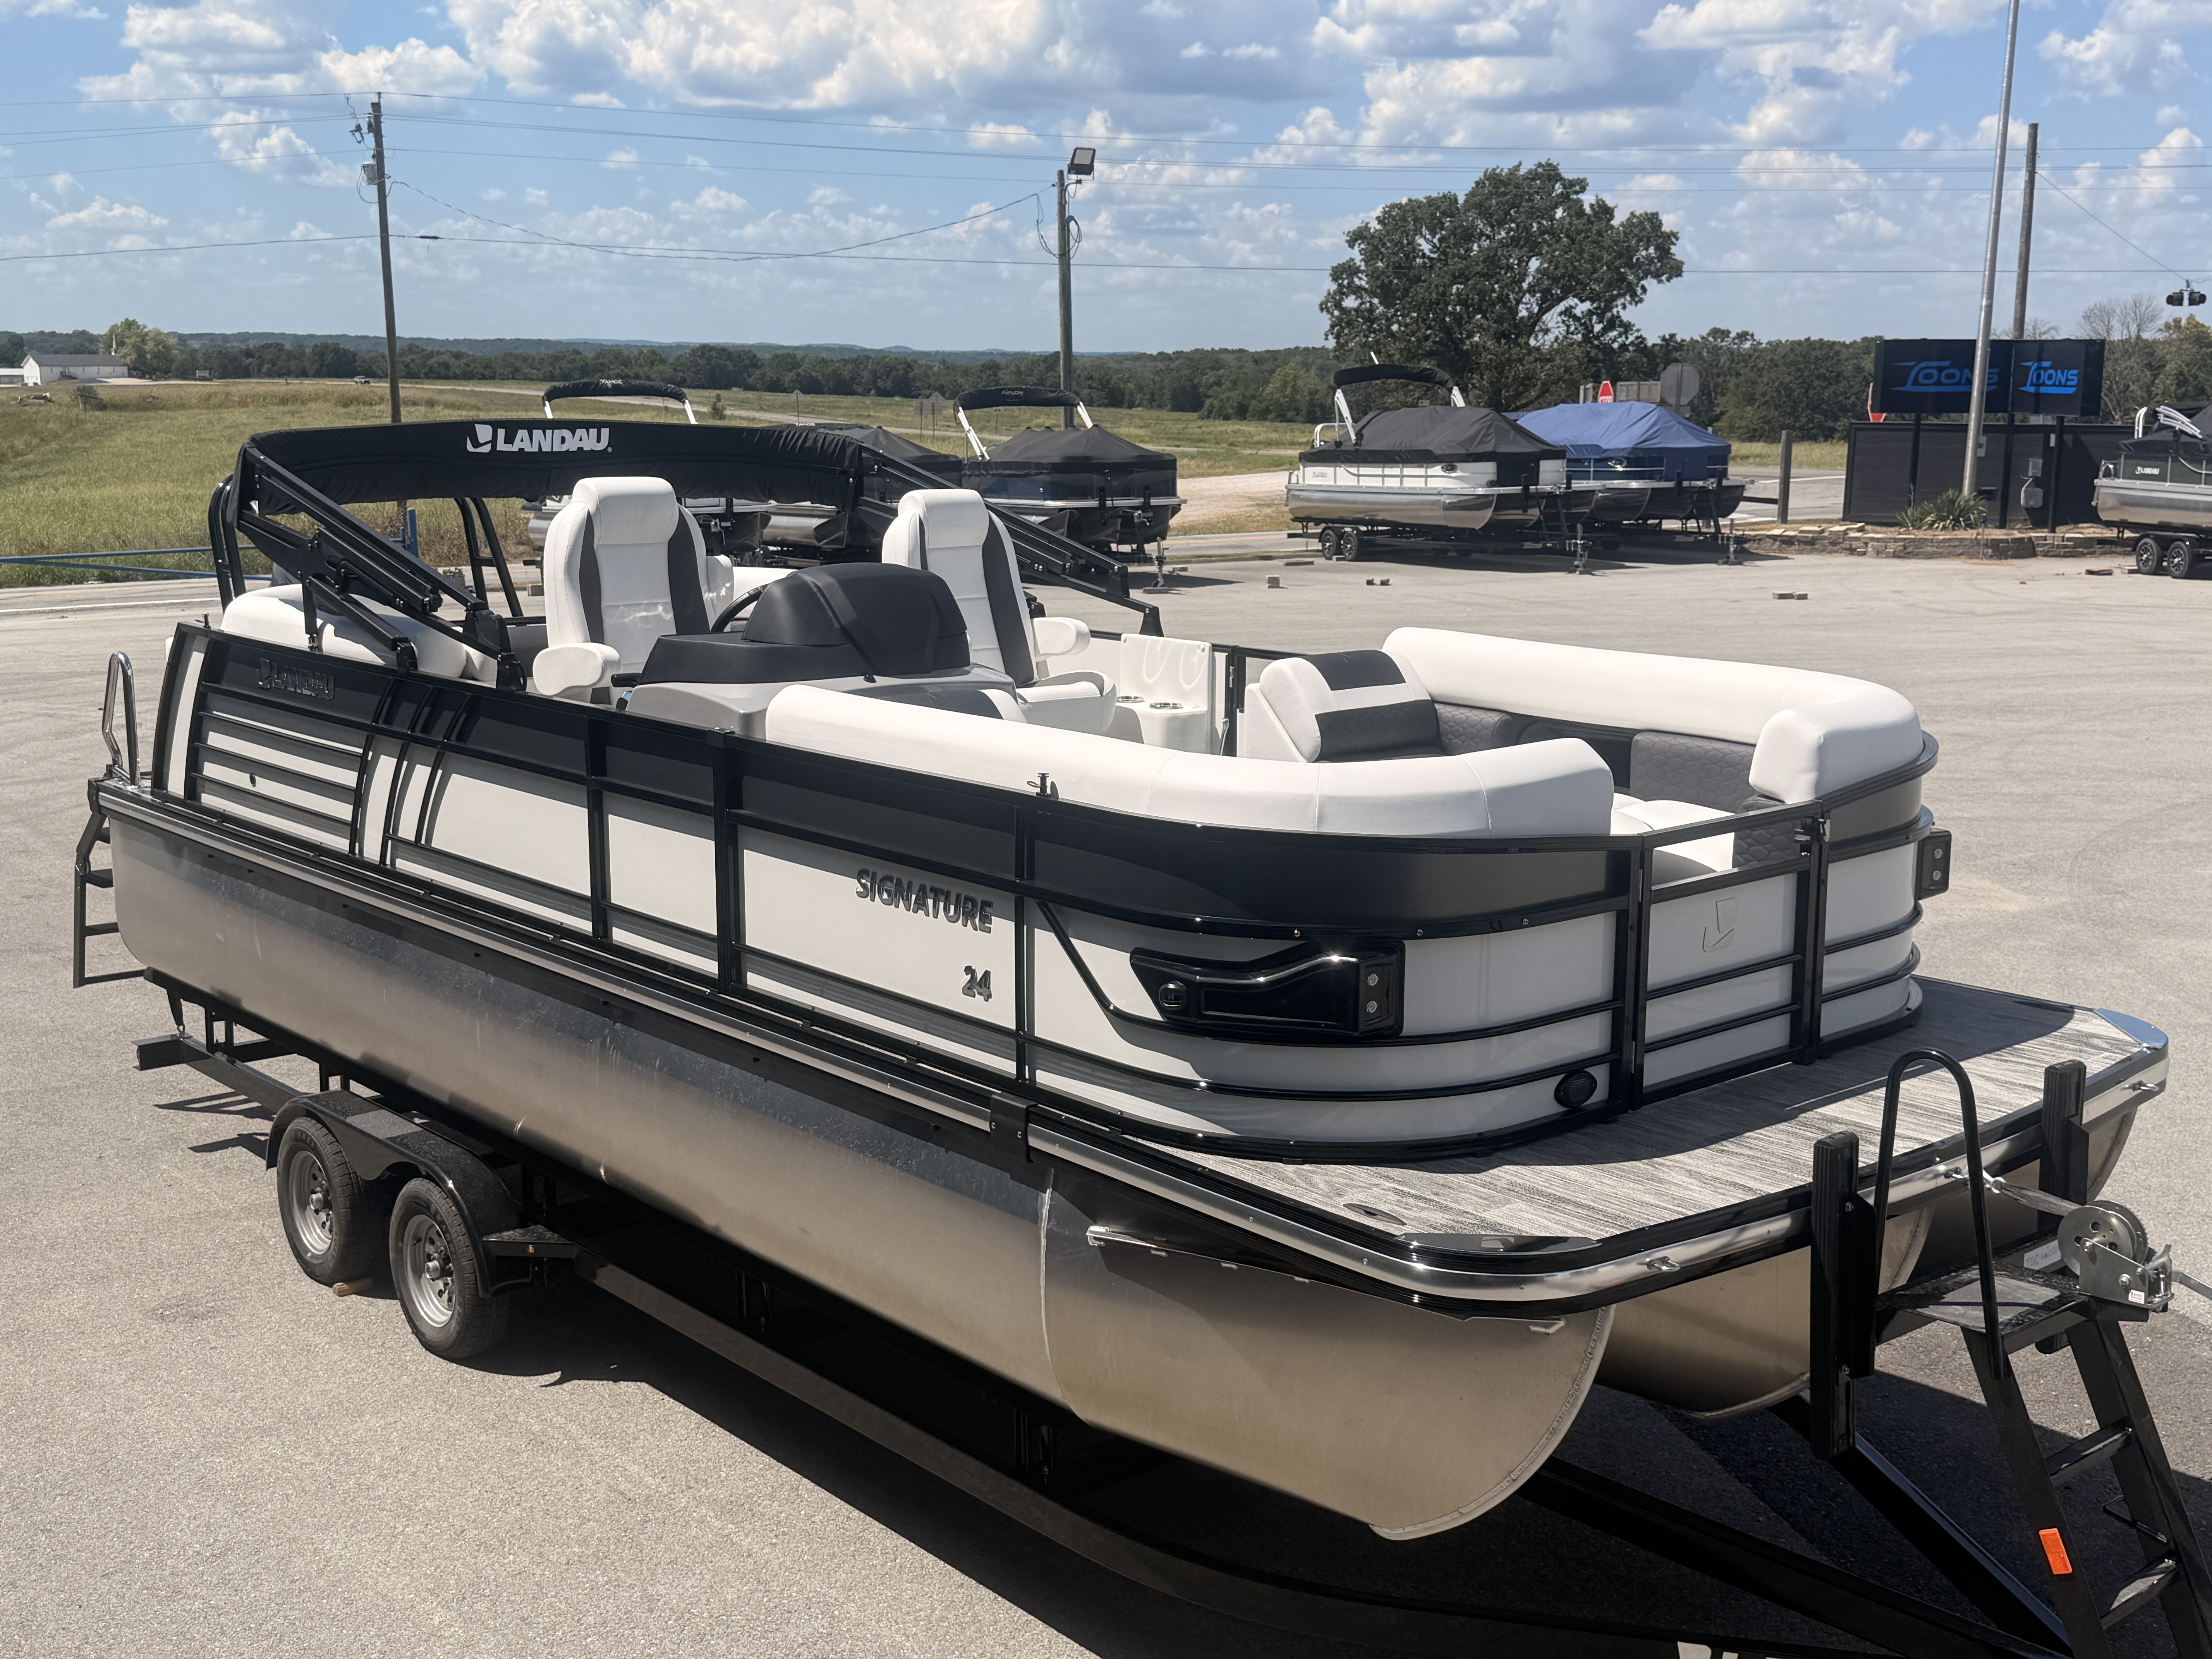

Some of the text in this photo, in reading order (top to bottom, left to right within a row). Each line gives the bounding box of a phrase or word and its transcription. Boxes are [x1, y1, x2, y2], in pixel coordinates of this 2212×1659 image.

[2018, 361, 2080, 394] TOONS
[496, 428, 610, 452] LANDAU
[856, 867, 993, 934] SIGNATURE
[962, 965, 992, 1002] 24
